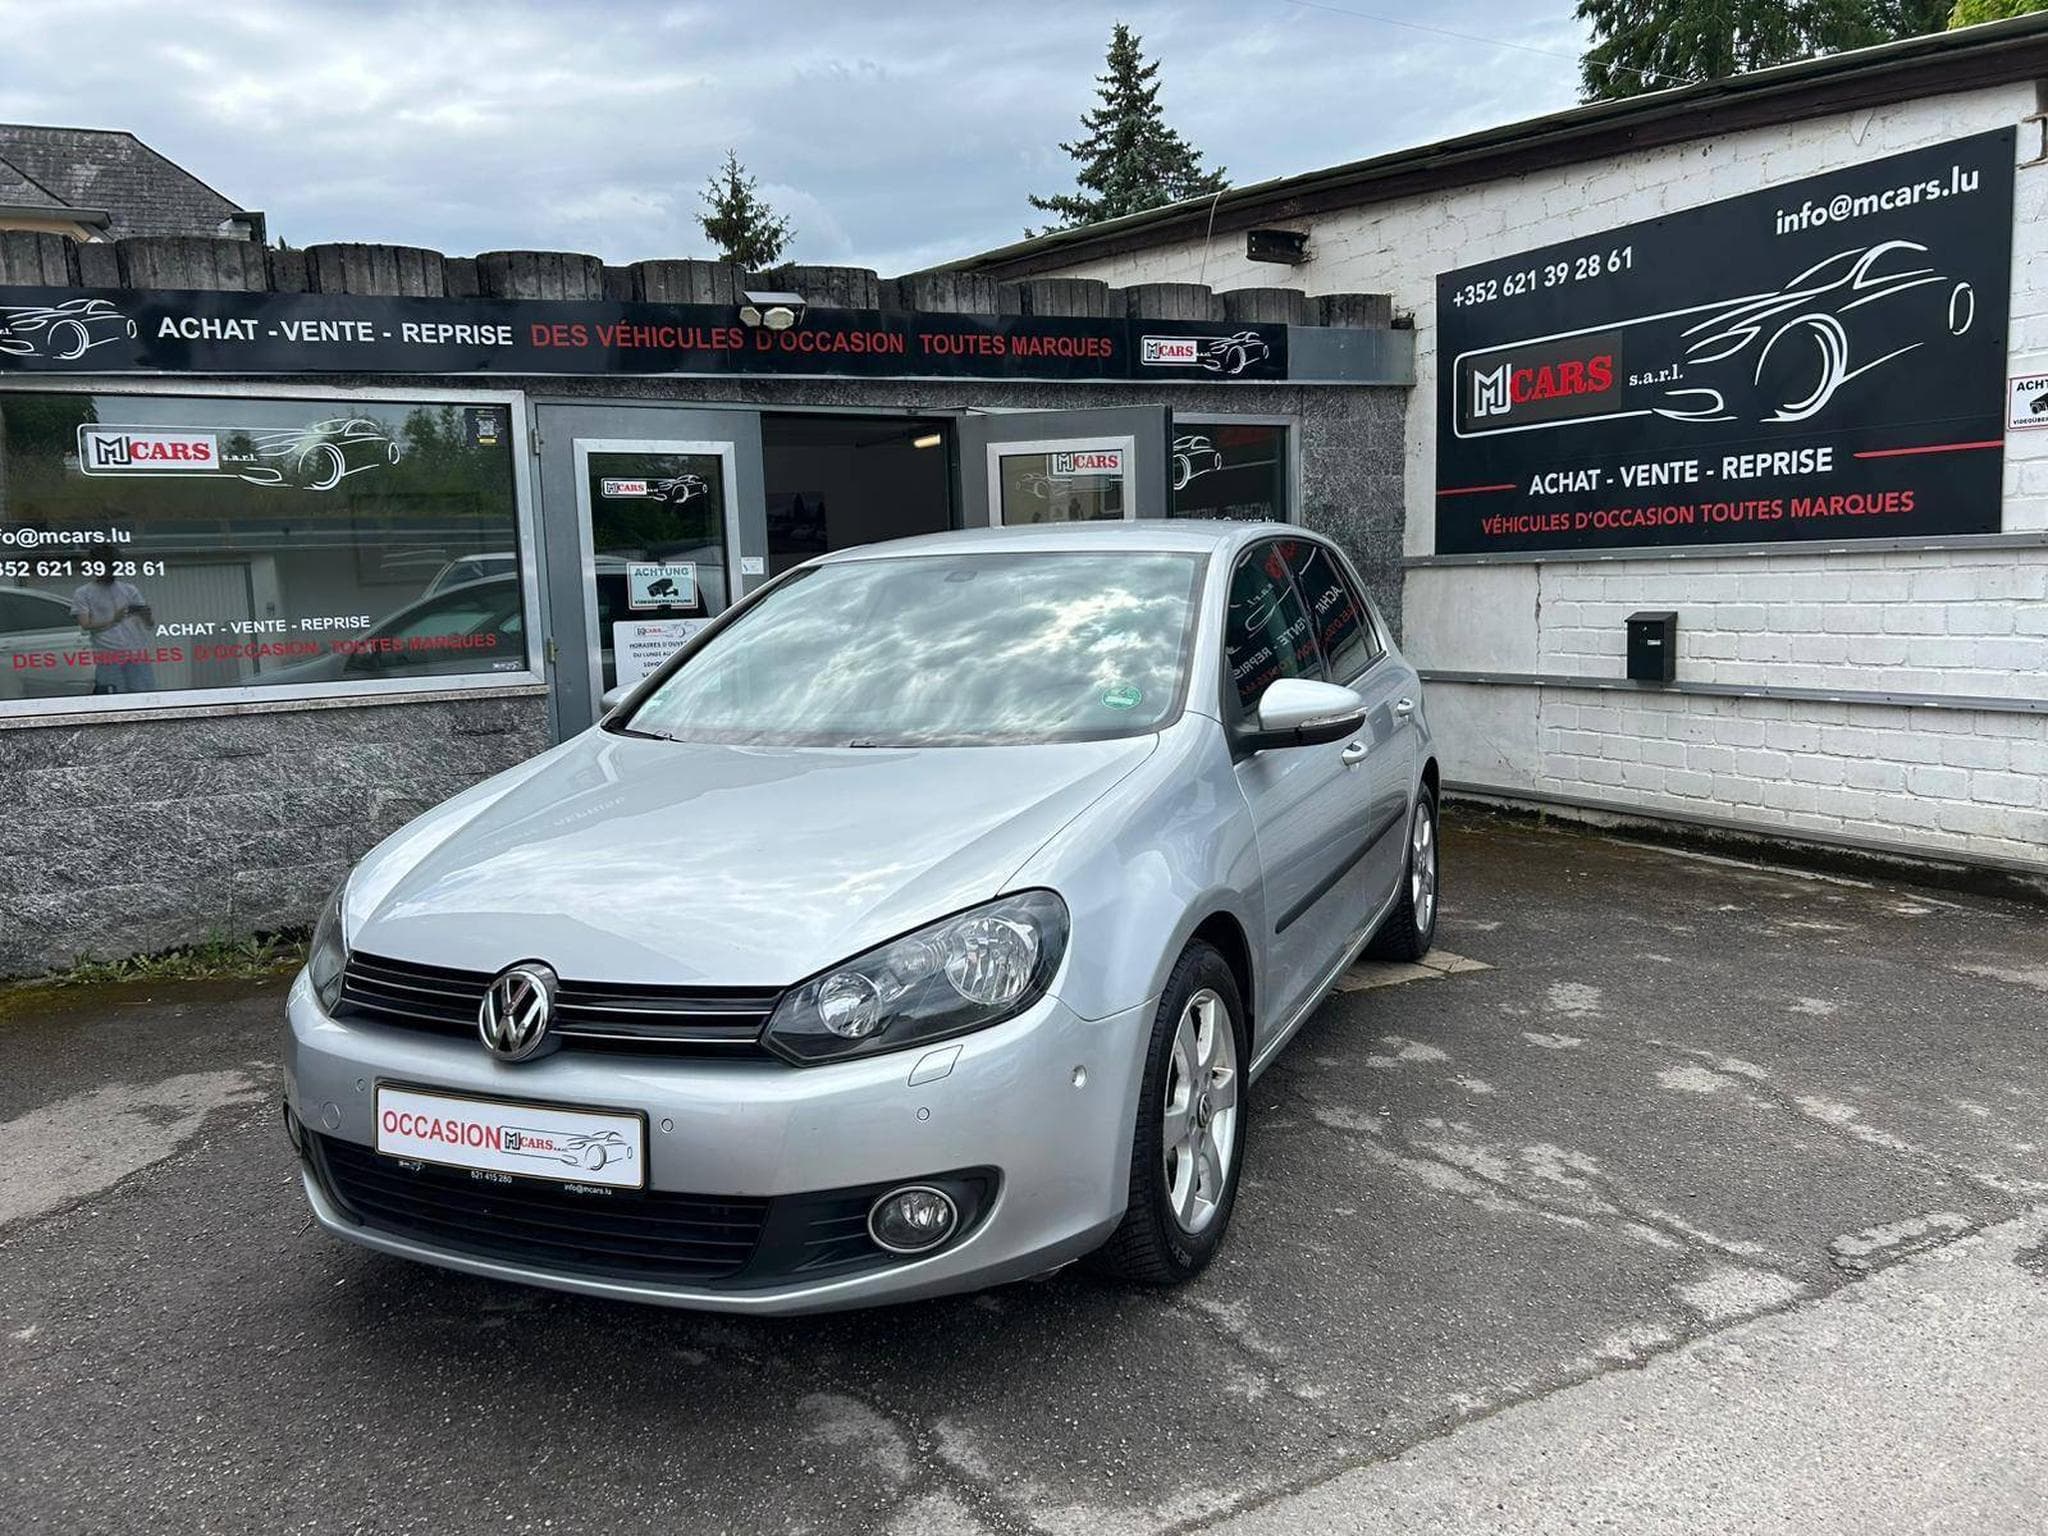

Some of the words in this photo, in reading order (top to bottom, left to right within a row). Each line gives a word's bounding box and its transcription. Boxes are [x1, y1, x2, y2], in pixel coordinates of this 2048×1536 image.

[1776, 164, 1979, 235] info@mcars.lu
[1453, 279, 1498, 308] +352
[1503, 269, 1537, 297] 621
[1544, 262, 1569, 287] 39
[1574, 255, 1601, 281] 28
[1607, 246, 1634, 273] 61
[157, 318, 258, 341] ACHAT
[402, 322, 513, 346] REPRISE
[531, 324, 589, 347] DES
[596, 318, 744, 350] VÉHICULES
[756, 329, 905, 355] D'OCCASION
[919, 333, 1006, 356] TOUTES
[1012, 335, 1113, 358] MARQUES
[1628, 363, 1684, 386] s.a.r.l.
[222, 452, 258, 462] s.a.r.l.
[1528, 469, 1600, 496] ACHAT
[1619, 460, 1699, 488] VENTE
[1722, 447, 1834, 480] REPRISE
[1481, 512, 1570, 535] VÉHICULES
[1575, 504, 1695, 530] D'OCCASION
[1699, 497, 1784, 523] TOUTES
[1790, 490, 1916, 518] MARQUES
[36, 560, 73, 577] 621
[81, 560, 106, 577] 39
[112, 560, 137, 577] 28
[143, 560, 165, 577] 61
[634, 567, 689, 577] ACHTUNG
[156, 622, 216, 637] ACHAT
[231, 619, 286, 635] VENTE
[301, 615, 371, 631] REPRISE
[13, 653, 57, 670] DES
[409, 633, 496, 652] MARQUES
[382, 1110, 500, 1150] OCCASION
